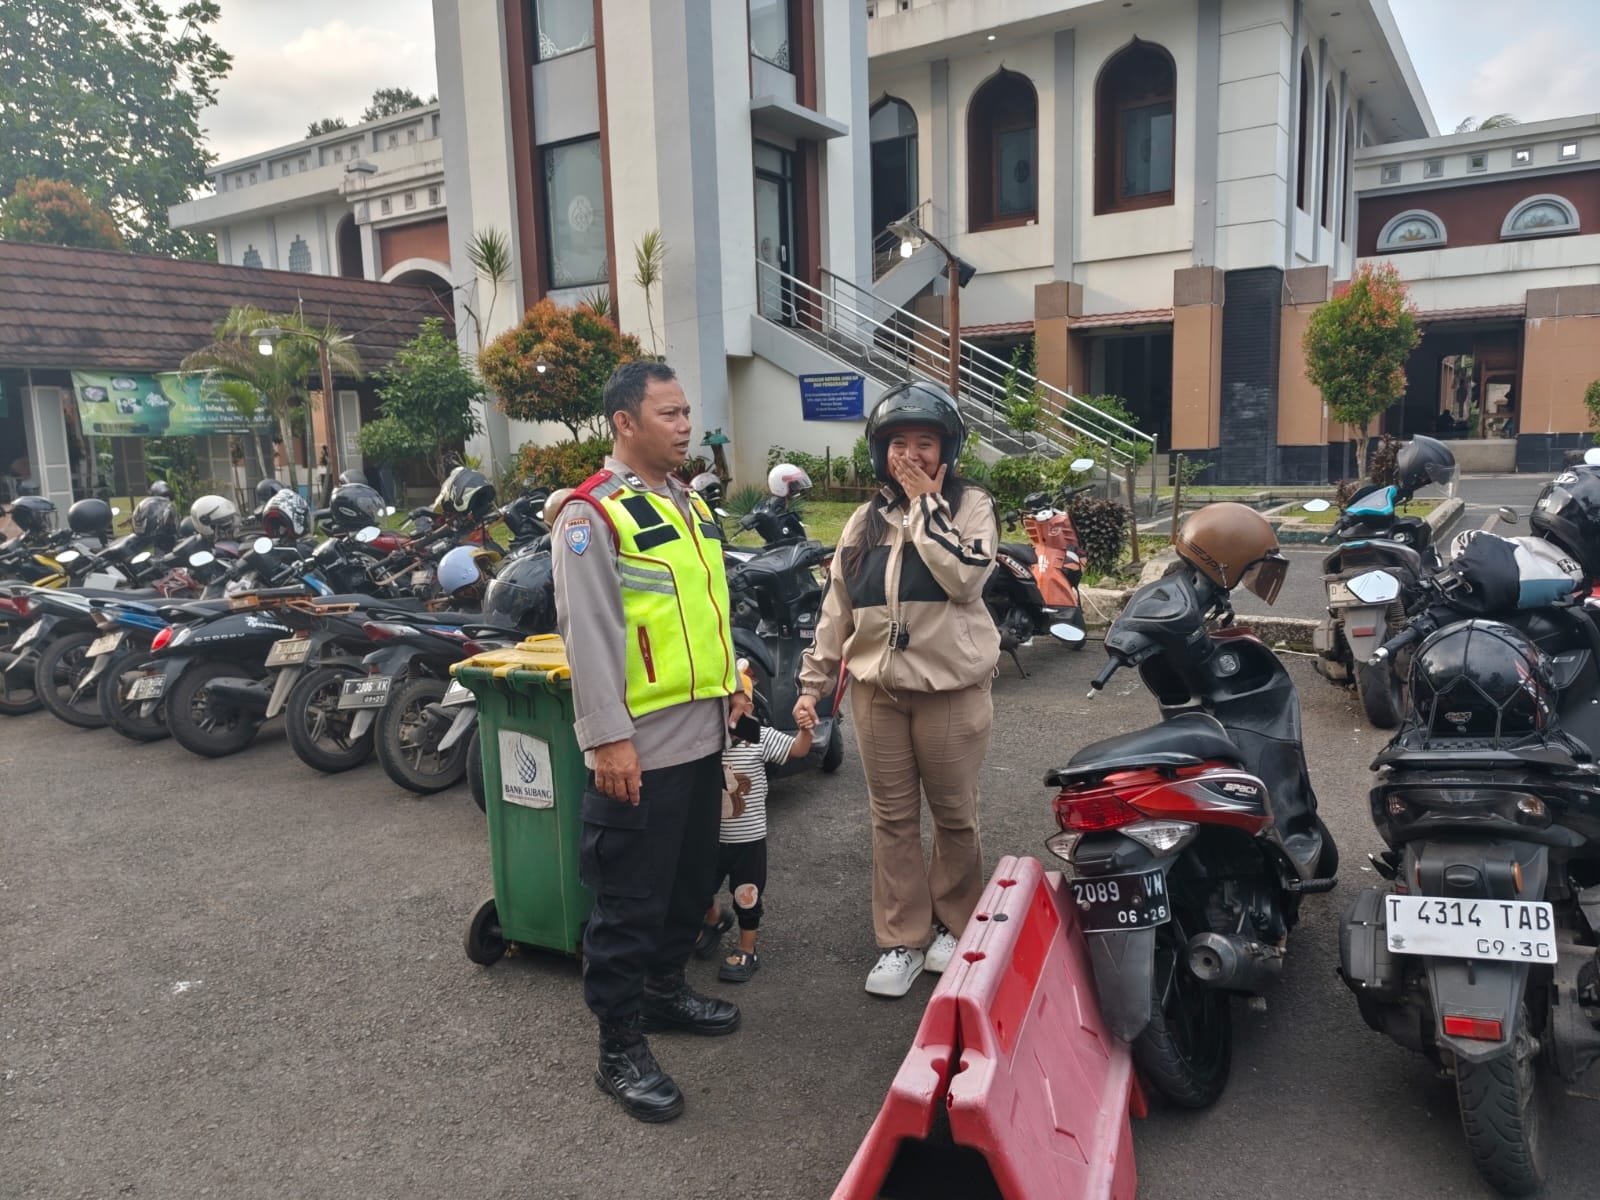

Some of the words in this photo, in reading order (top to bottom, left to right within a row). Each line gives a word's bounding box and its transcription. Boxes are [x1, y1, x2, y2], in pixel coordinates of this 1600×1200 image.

[504, 783, 523, 796] BANK
[524, 786, 552, 800] SUBANG
[1073, 880, 1120, 905] 2089
[1388, 899, 1401, 922] T
[1417, 900, 1482, 927] 4314
[1499, 904, 1550, 931] TAB
